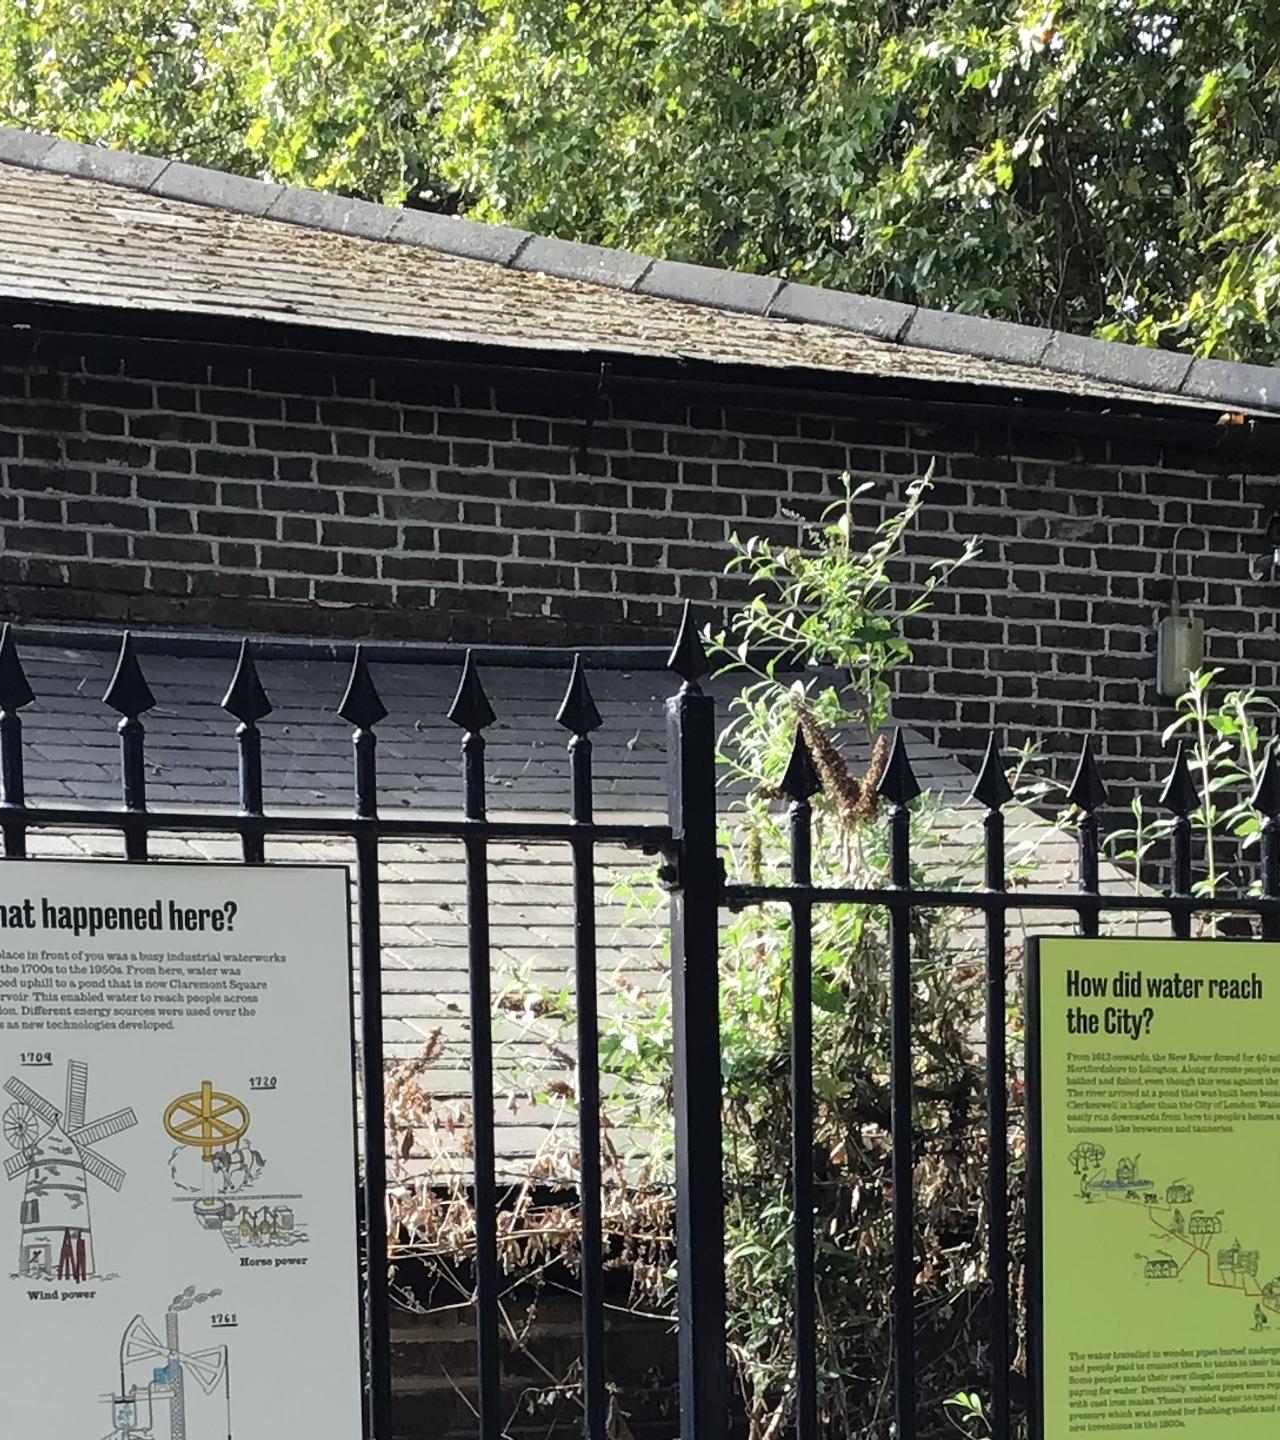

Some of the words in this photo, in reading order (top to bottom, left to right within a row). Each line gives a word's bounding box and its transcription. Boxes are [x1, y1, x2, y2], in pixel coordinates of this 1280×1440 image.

[41, 896, 163, 936] happened
[168, 898, 238, 930] here?
[26, 951, 39, 960] in
[40, 951, 70, 960] front
[71, 951, 83, 961] of
[84, 953, 105, 963] you
[138, 952, 164, 963] busy
[166, 952, 221, 962] industrial
[222, 952, 287, 962] waterworks
[0, 965, 19, 974] the
[21, 965, 54, 974] 1700s
[55, 965, 68, 974] to
[68, 965, 88, 975] the
[126, 966, 156, 975] From
[186, 966, 218, 975] water
[219, 968, 242, 976] was
[19, 979, 54, 990] uphill
[55, 979, 67, 988] to
[77, 979, 106, 990] pond
[107, 979, 132, 989] that
[133, 979, 143, 989] is
[168, 980, 227, 989] Claremont
[228, 980, 268, 991] Square
[1066, 970, 1107, 997] How
[1112, 971, 1142, 998] did
[1146, 971, 1203, 999] water
[1207, 972, 1263, 999] reach
[32, 992, 59, 1002] This
[60, 992, 104, 1002] enabled
[106, 993, 138, 1002] water
[140, 993, 152, 1002] to
[153, 993, 184, 1002] reach
[186, 993, 222, 1004] people
[1066, 1007, 1099, 1033] the
[1103, 1007, 1154, 1040] City?
[20, 1053, 52, 1063] 1709
[249, 1077, 277, 1086] 1720
[240, 1256, 273, 1265] Horse
[274, 1258, 308, 1267] power
[26, 1290, 59, 1298] Wind
[60, 1292, 96, 1300] power
